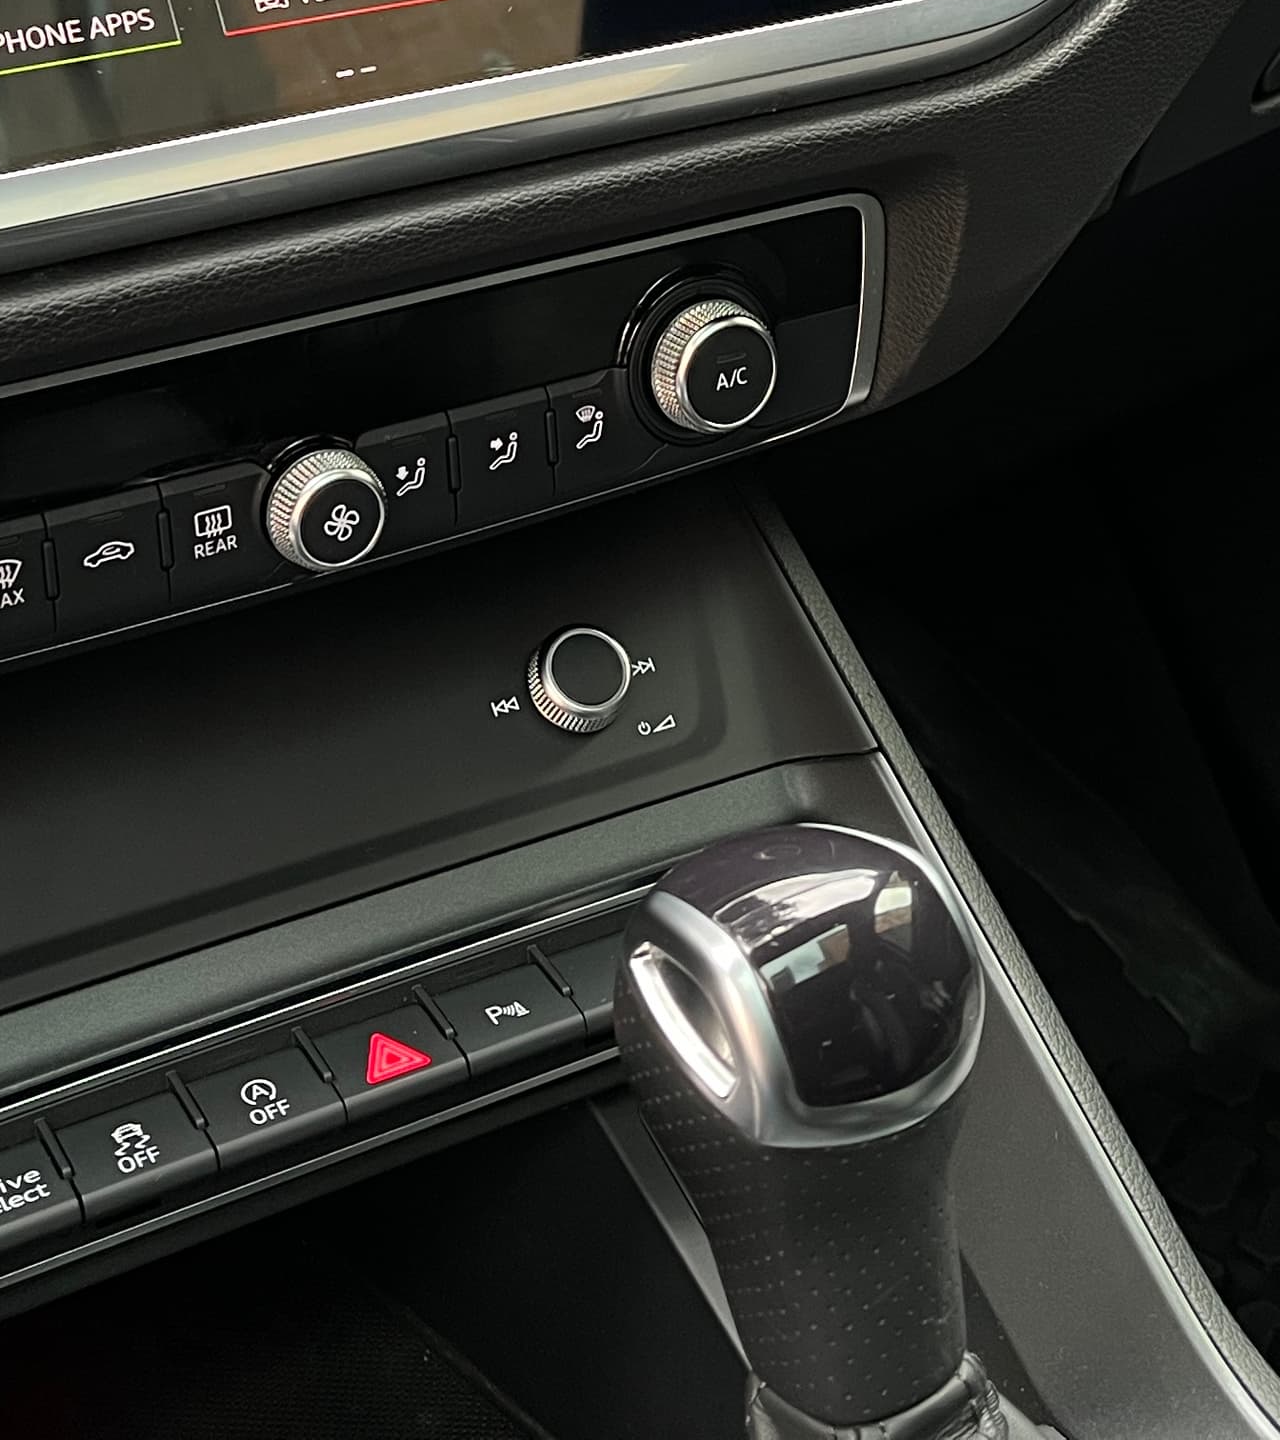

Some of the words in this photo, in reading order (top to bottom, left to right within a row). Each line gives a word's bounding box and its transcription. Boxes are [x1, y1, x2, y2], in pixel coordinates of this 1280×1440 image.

[89, 8, 156, 41] APPS
[715, 365, 748, 391] A/C
[193, 534, 239, 559] REAR
[249, 1098, 291, 1126] OFF
[116, 1145, 161, 1174] OFF
